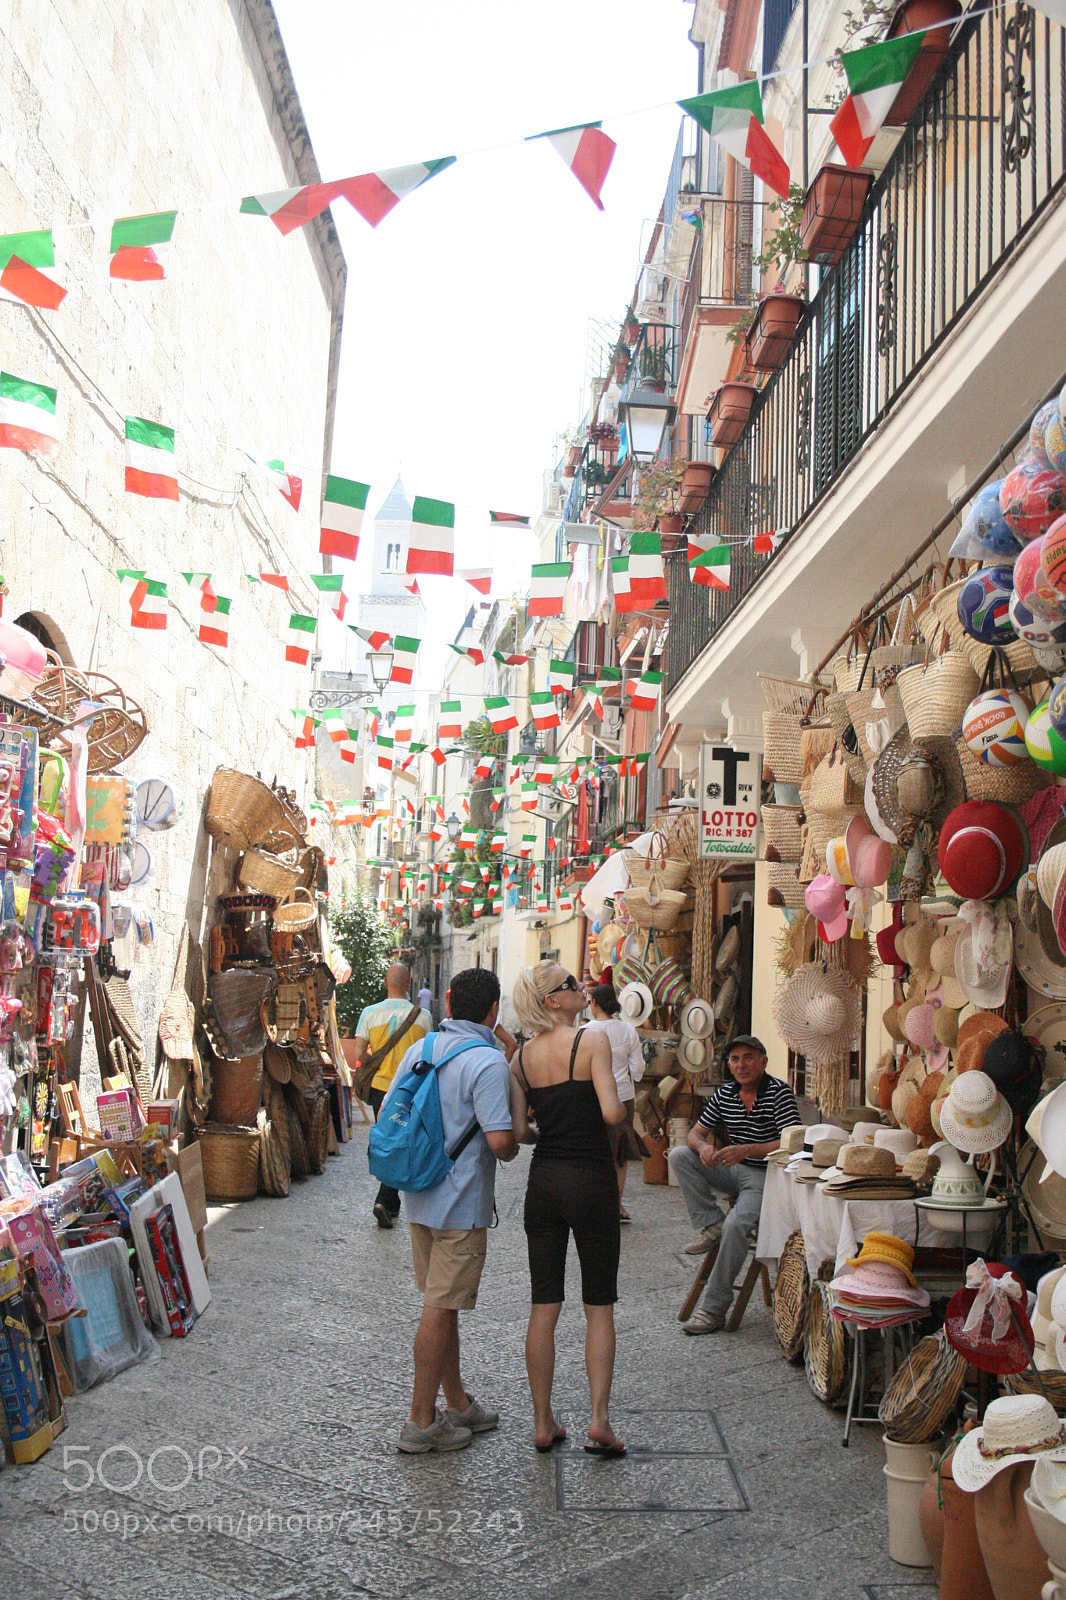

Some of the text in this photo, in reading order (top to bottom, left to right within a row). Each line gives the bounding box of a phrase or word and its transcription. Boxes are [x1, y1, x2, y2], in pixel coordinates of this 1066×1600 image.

[984, 711, 1006, 725] ROCK
[712, 748, 749, 805] T
[742, 794, 748, 803] 4
[702, 810, 757, 828] LOTTO
[735, 829, 753, 838] 387
[703, 839, 756, 854] Totocalcio
